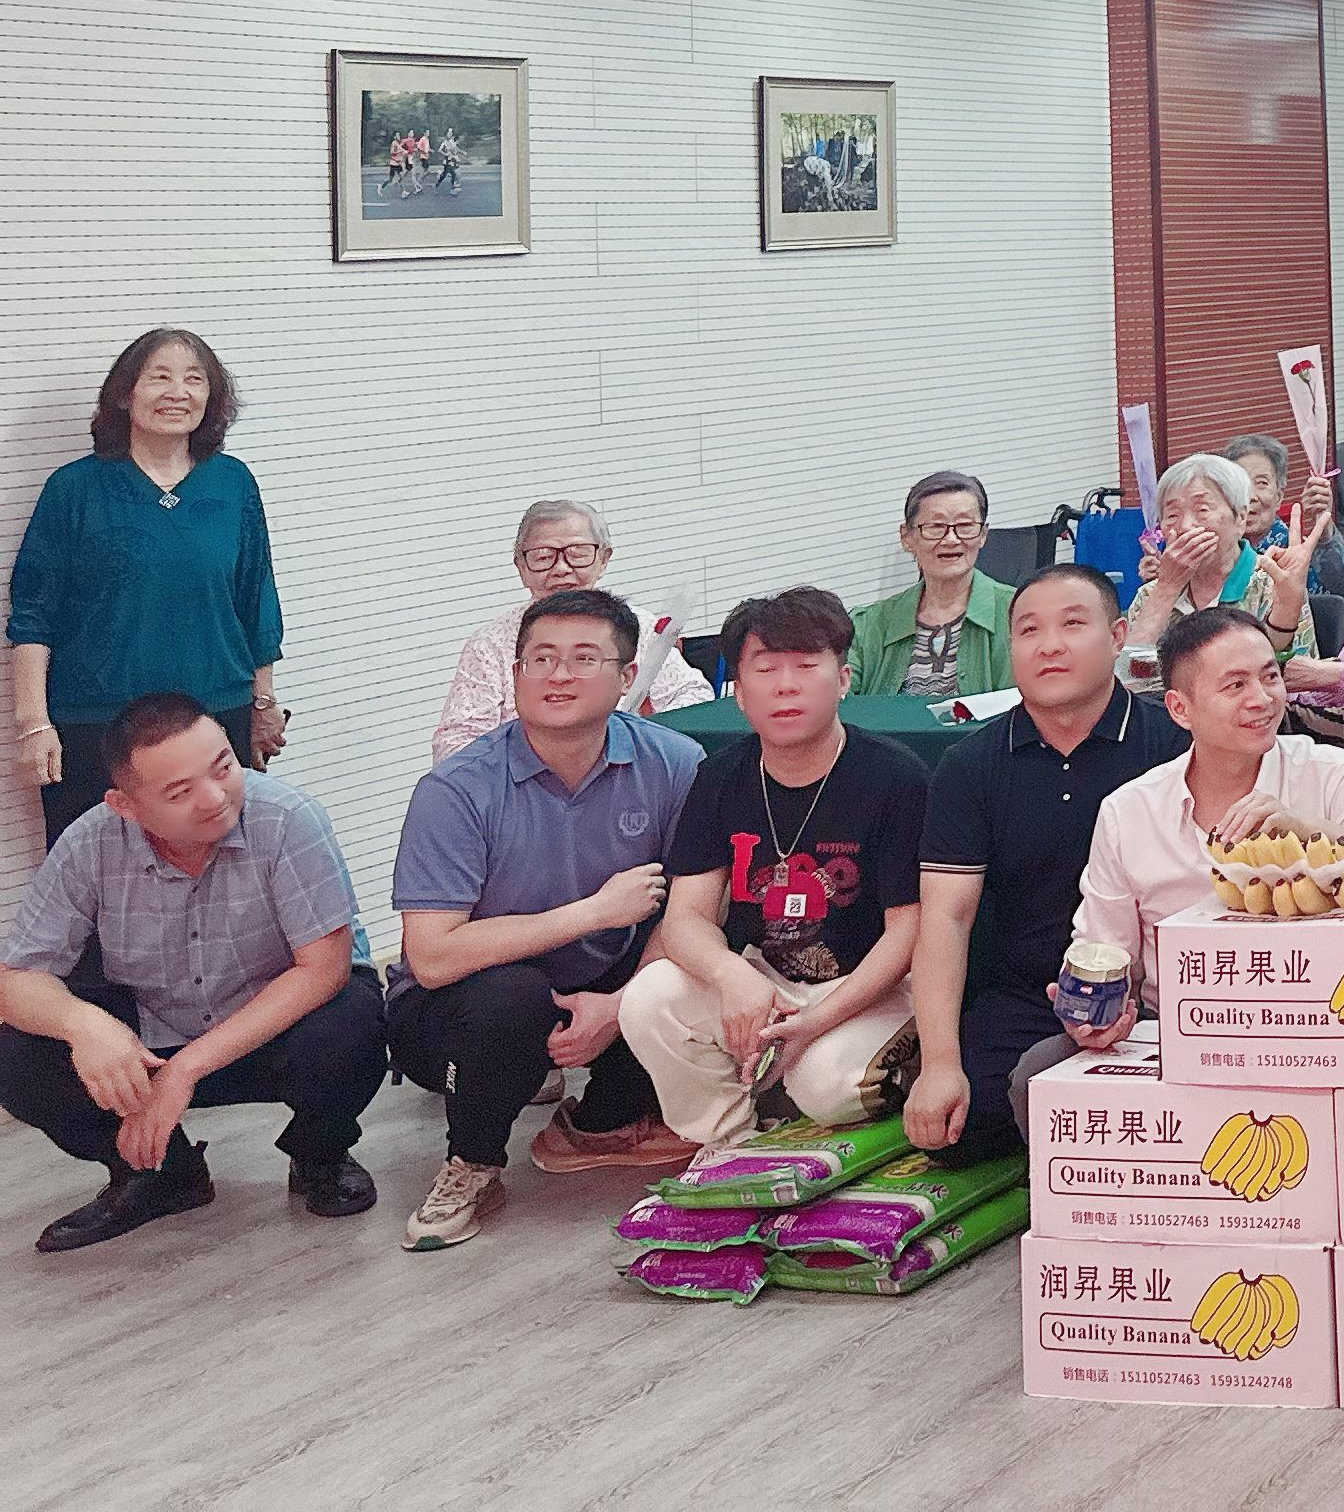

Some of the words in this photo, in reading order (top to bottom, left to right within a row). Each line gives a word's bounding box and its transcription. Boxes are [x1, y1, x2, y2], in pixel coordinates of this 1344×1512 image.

[1178, 949, 1312, 986] 润昇果业
[1189, 1007, 1256, 1029] Quality
[1261, 1008, 1330, 1026] Banana
[1257, 1054, 1338, 1067] 15110527463
[1050, 1108, 1183, 1146] 润昇果业
[1060, 1165, 1126, 1188] Quality
[1131, 1169, 1201, 1187] Banana
[1128, 1213, 1209, 1228] 15110527463
[1219, 1216, 1301, 1230] 15931242748
[1040, 1263, 1173, 1303] 润昇果业
[1051, 1321, 1117, 1346] Quality
[1123, 1326, 1192, 1345] Banana
[1120, 1369, 1201, 1386] 15110527463
[1210, 1374, 1293, 1389] 15931242748
